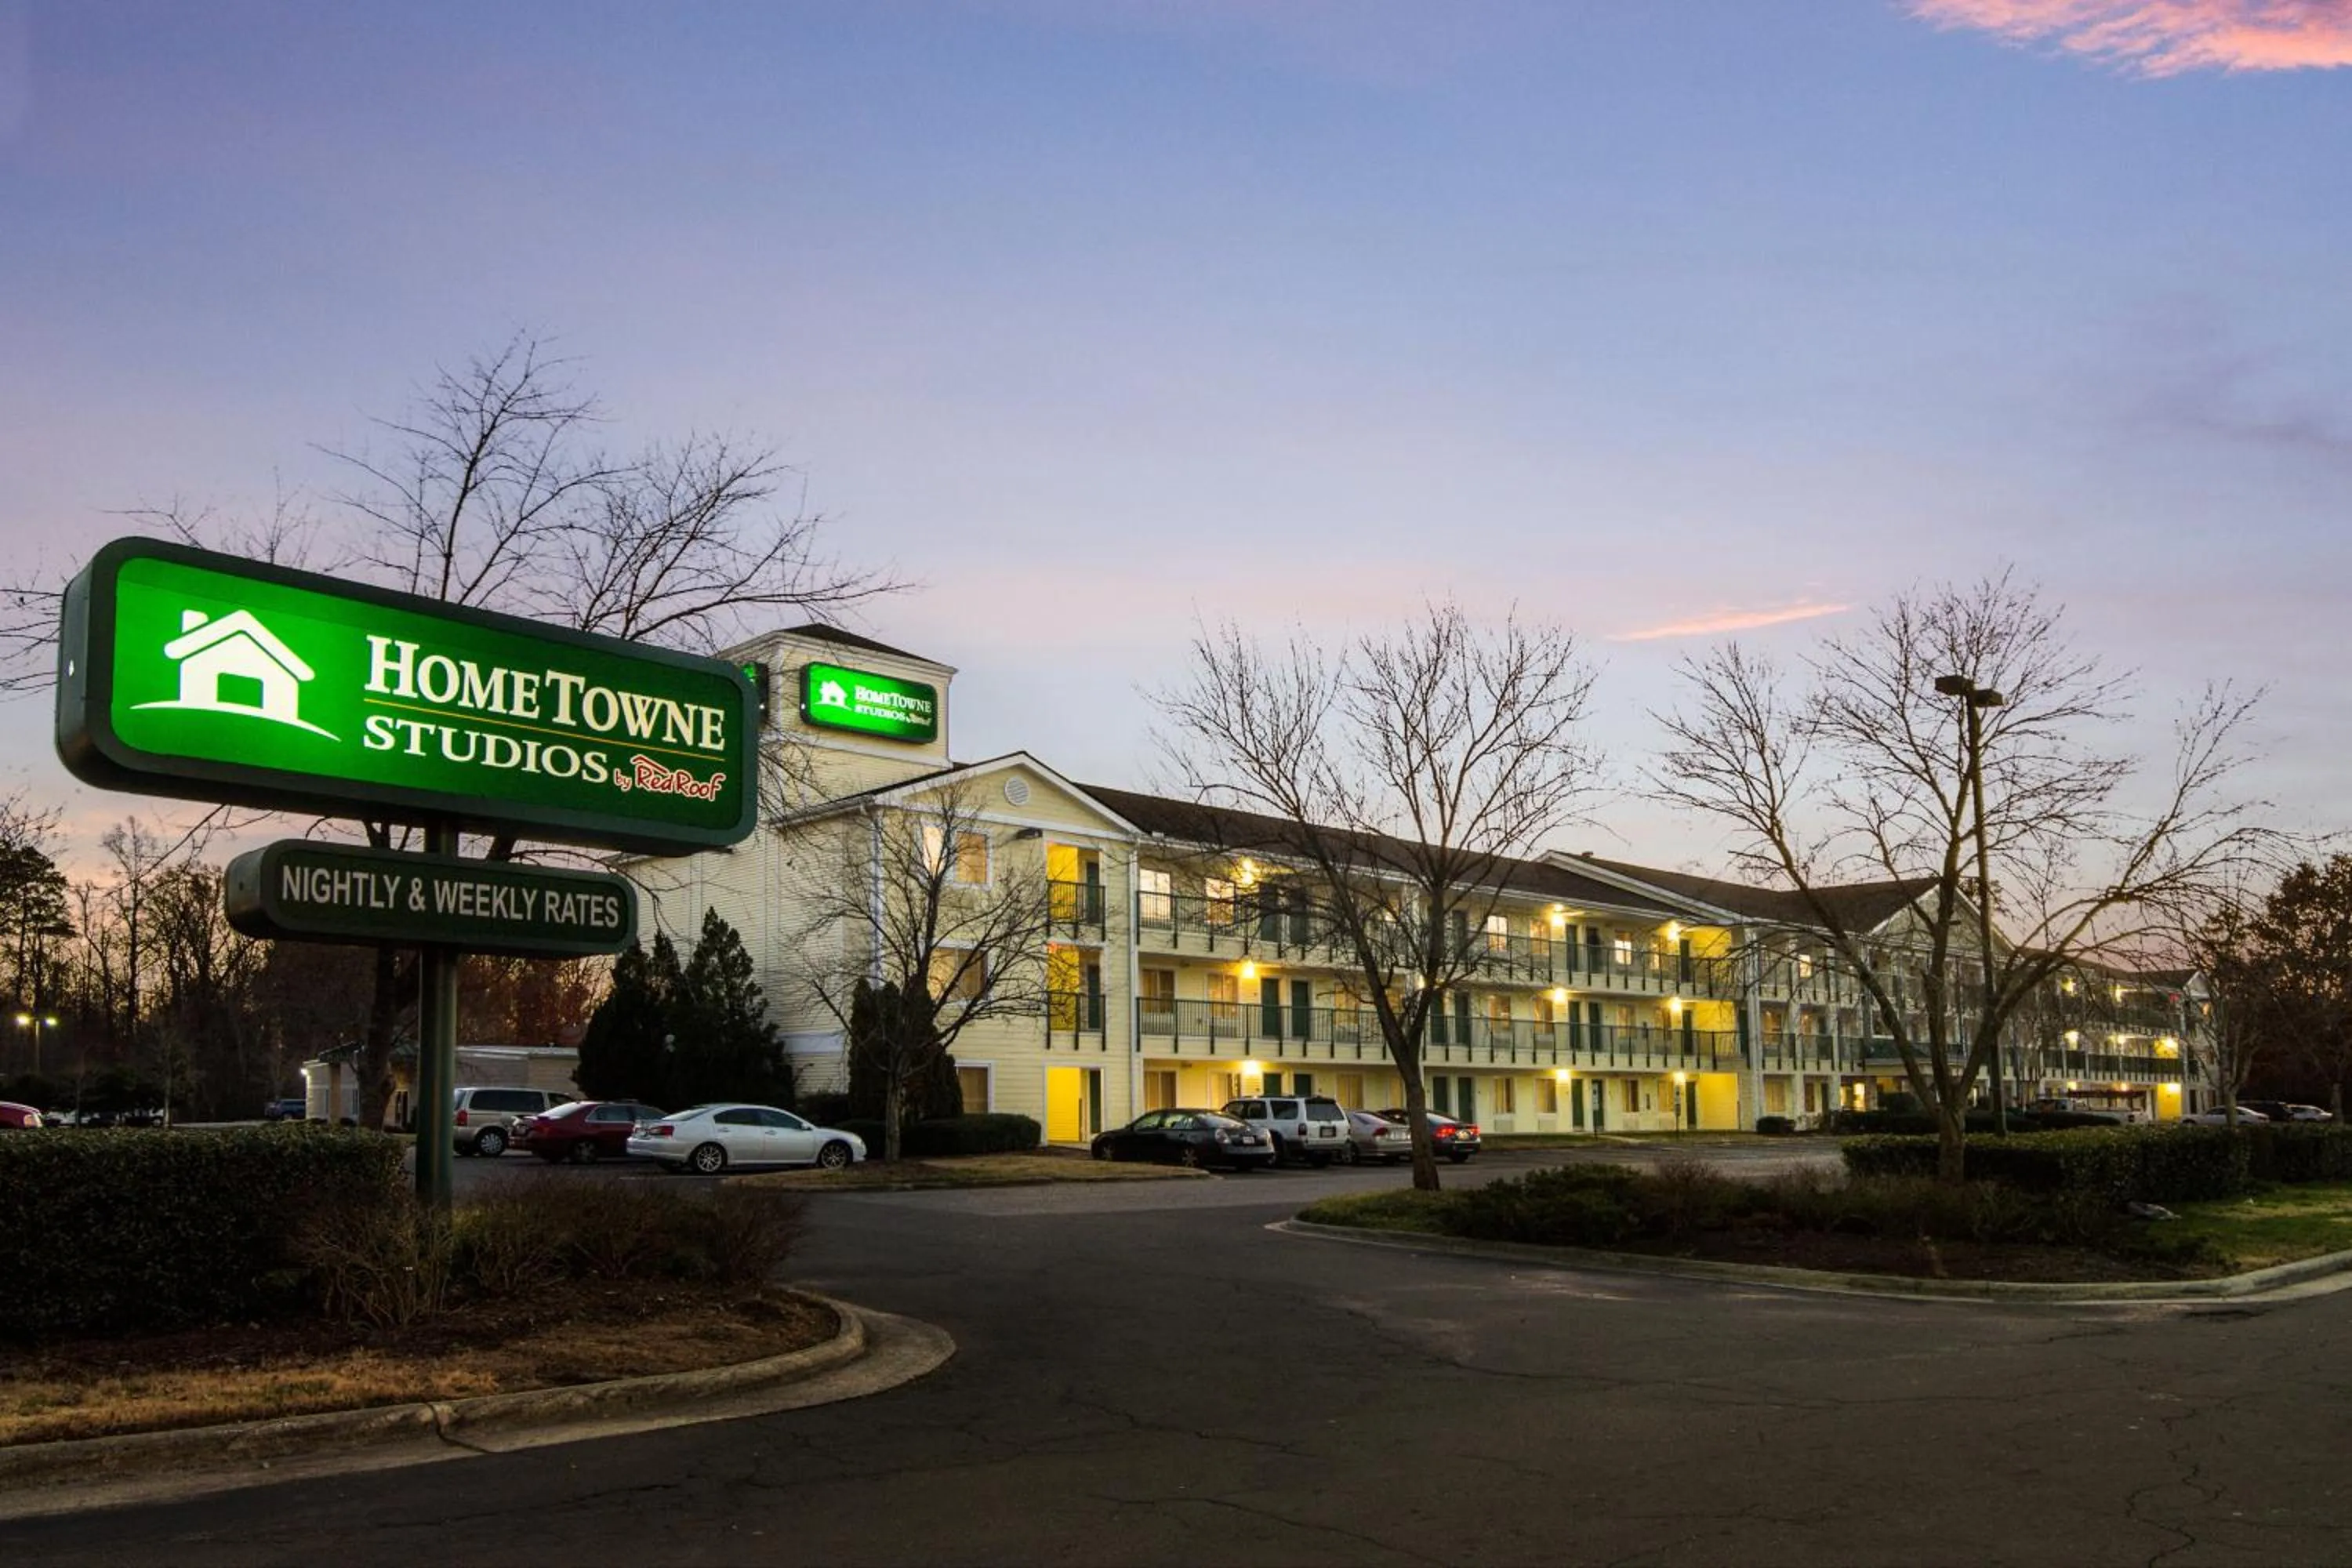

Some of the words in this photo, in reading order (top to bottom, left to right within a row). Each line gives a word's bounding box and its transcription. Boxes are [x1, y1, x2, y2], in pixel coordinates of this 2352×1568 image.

[364, 634, 726, 751] HOMETOWNE
[363, 715, 608, 783] STUDIOS
[613, 768, 633, 791] by
[281, 865, 401, 909] NIGHTLY
[408, 877, 426, 912] &
[434, 879, 538, 920] WEEKLY
[544, 890, 619, 928] RATES
